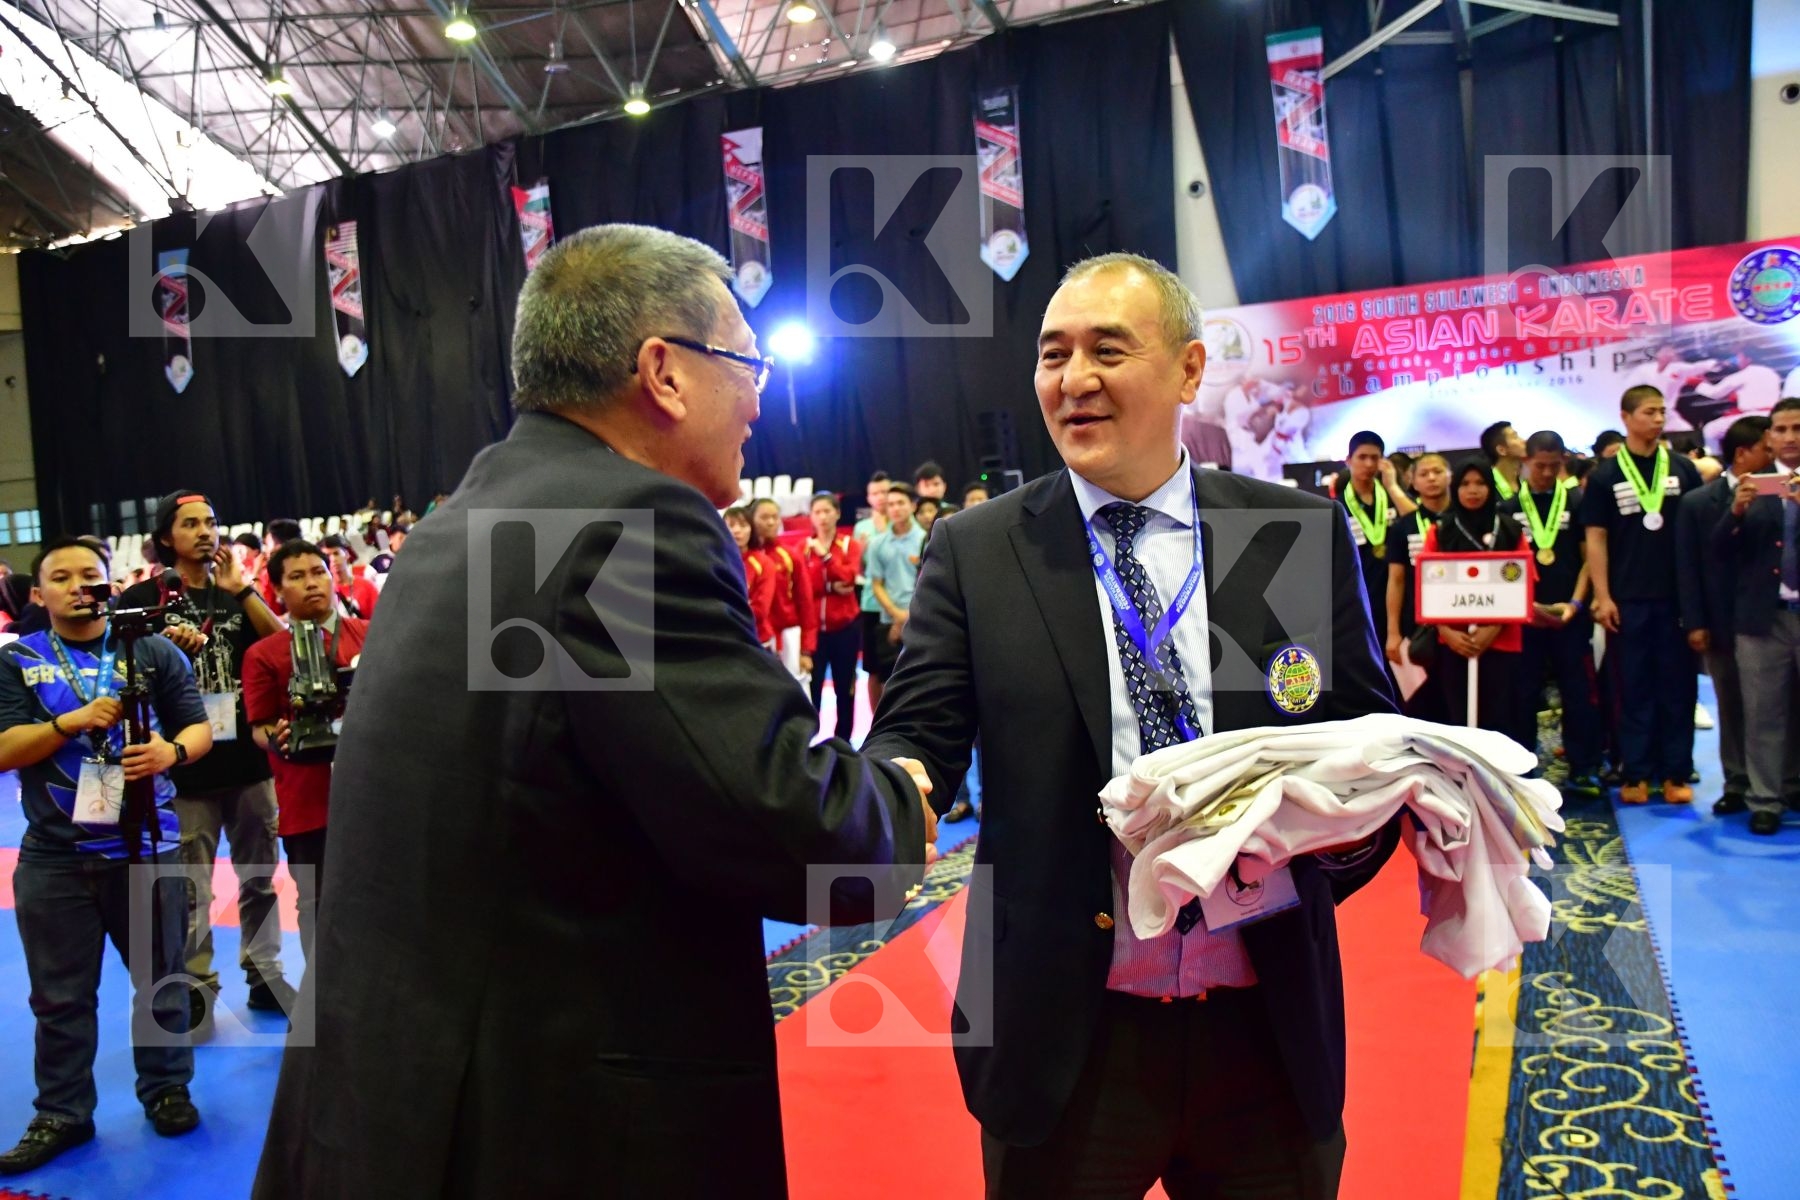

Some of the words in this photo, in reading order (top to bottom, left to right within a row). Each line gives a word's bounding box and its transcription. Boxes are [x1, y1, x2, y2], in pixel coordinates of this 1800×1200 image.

[1313, 304, 1357, 326] 2016
[1362, 293, 1420, 320] SOUTH
[1424, 282, 1518, 313] SULAWESI
[1539, 265, 1647, 299] INDONESIA
[1351, 309, 1500, 358] ASIAN
[1515, 283, 1715, 341] KARATE
[1451, 593, 1495, 608] JAPAN
